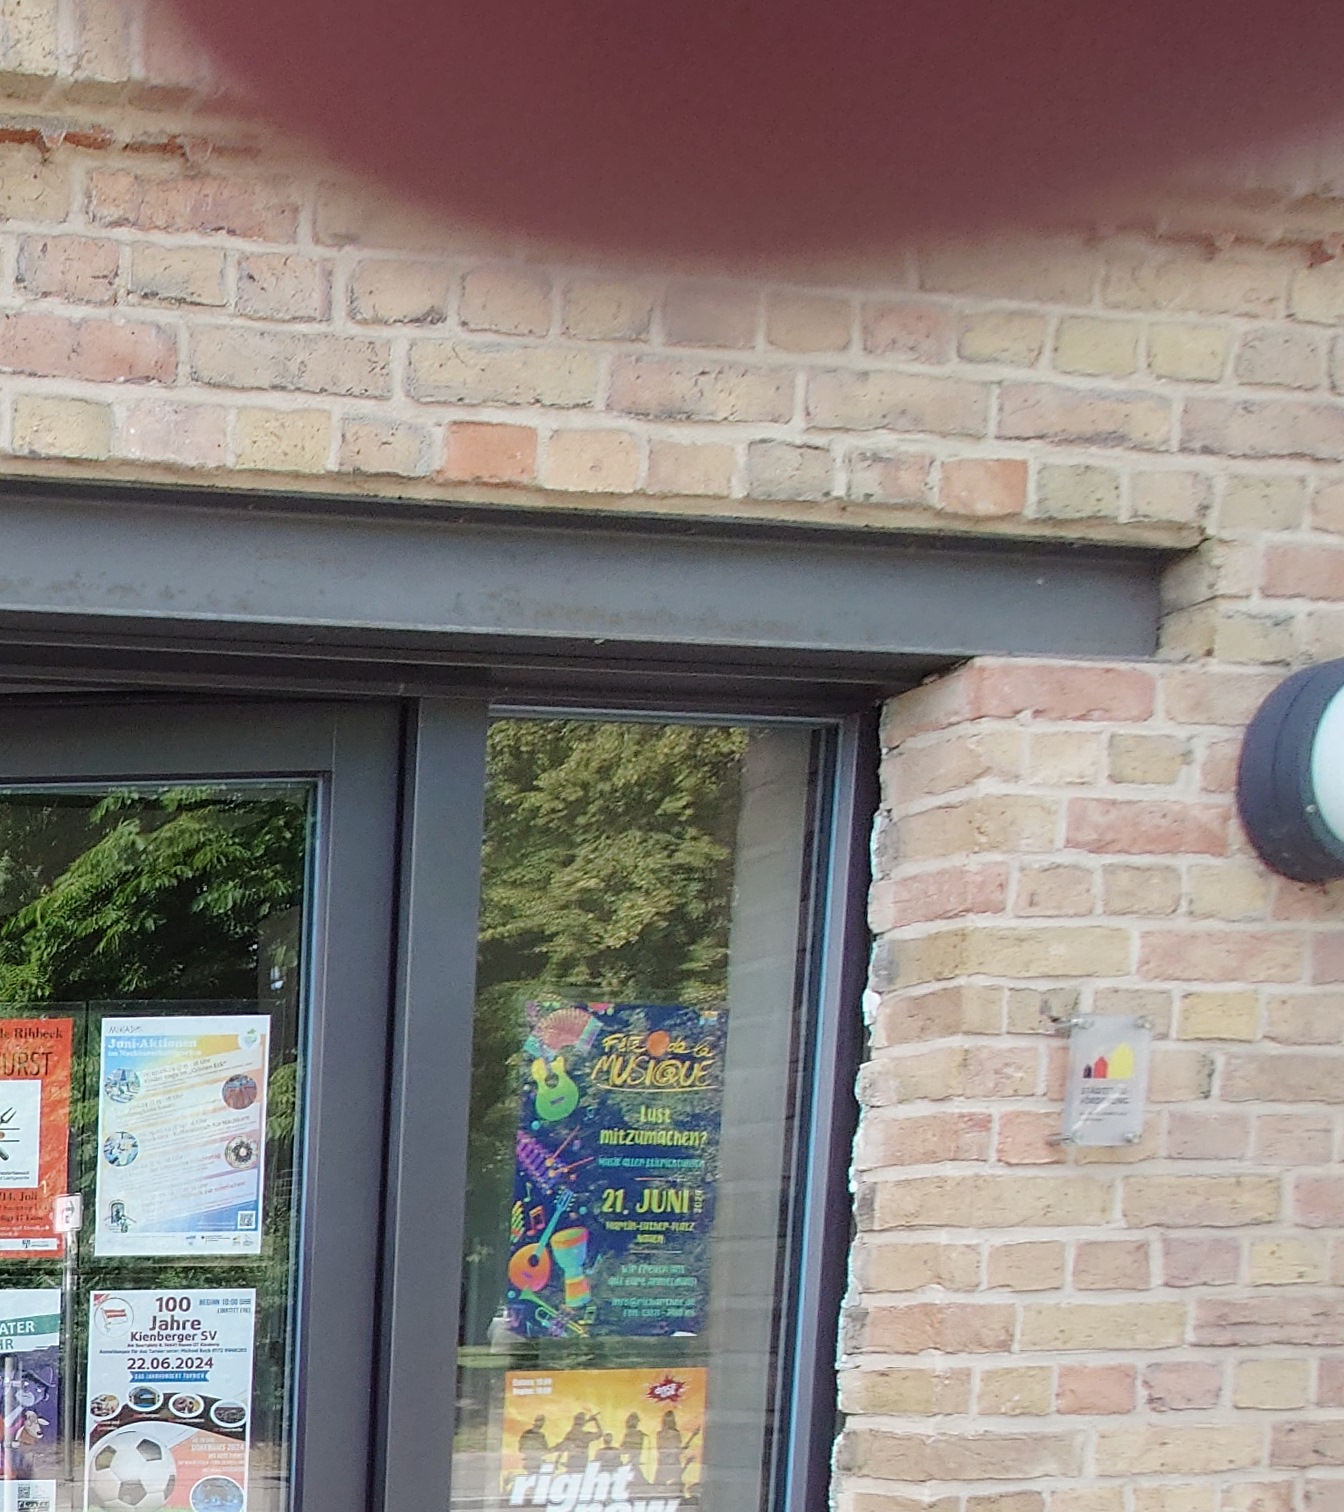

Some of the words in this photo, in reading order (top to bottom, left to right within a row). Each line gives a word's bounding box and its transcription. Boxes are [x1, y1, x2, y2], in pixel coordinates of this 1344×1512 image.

[108, 1038, 197, 1050] Juni-Aktionen
[640, 1105, 672, 1122] Lust
[600, 1127, 708, 1148] mitzumachen?
[20, 1192, 38, 1202] Juli
[602, 1188, 629, 1214] 21.
[636, 1189, 690, 1214] JUNI
[155, 1296, 192, 1312] 100
[149, 1315, 202, 1331] Jahre
[130, 1332, 198, 1342] Kienberger
[200, 1331, 218, 1340] SV
[127, 1357, 214, 1370] 22.06.2024
